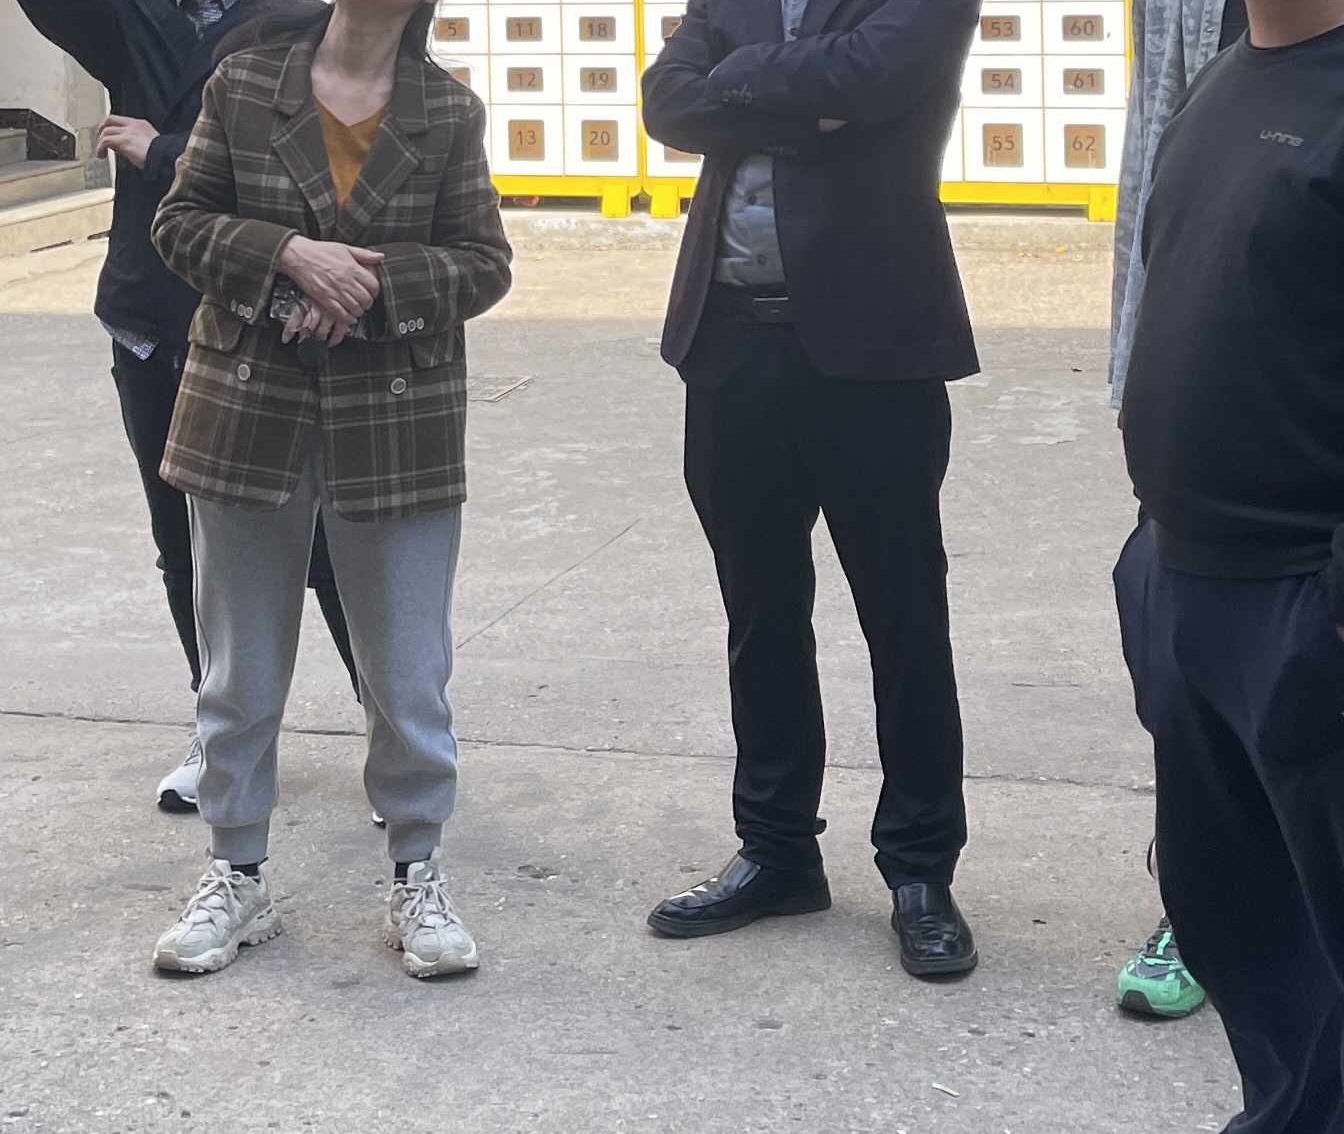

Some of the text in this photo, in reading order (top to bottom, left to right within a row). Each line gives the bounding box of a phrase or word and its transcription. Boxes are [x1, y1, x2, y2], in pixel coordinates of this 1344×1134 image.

[447, 22, 457, 37] 5
[516, 23, 534, 36] 11
[587, 23, 607, 37] 18
[991, 21, 1013, 37] 53
[1070, 20, 1094, 35] 60
[517, 72, 536, 87] 12
[588, 72, 609, 87] 19
[991, 73, 1014, 88] 54
[1073, 72, 1095, 88] 61
[516, 130, 536, 145] 13
[589, 131, 610, 147] 20
[992, 135, 1015, 151] 55
[1072, 135, 1096, 151] 62
